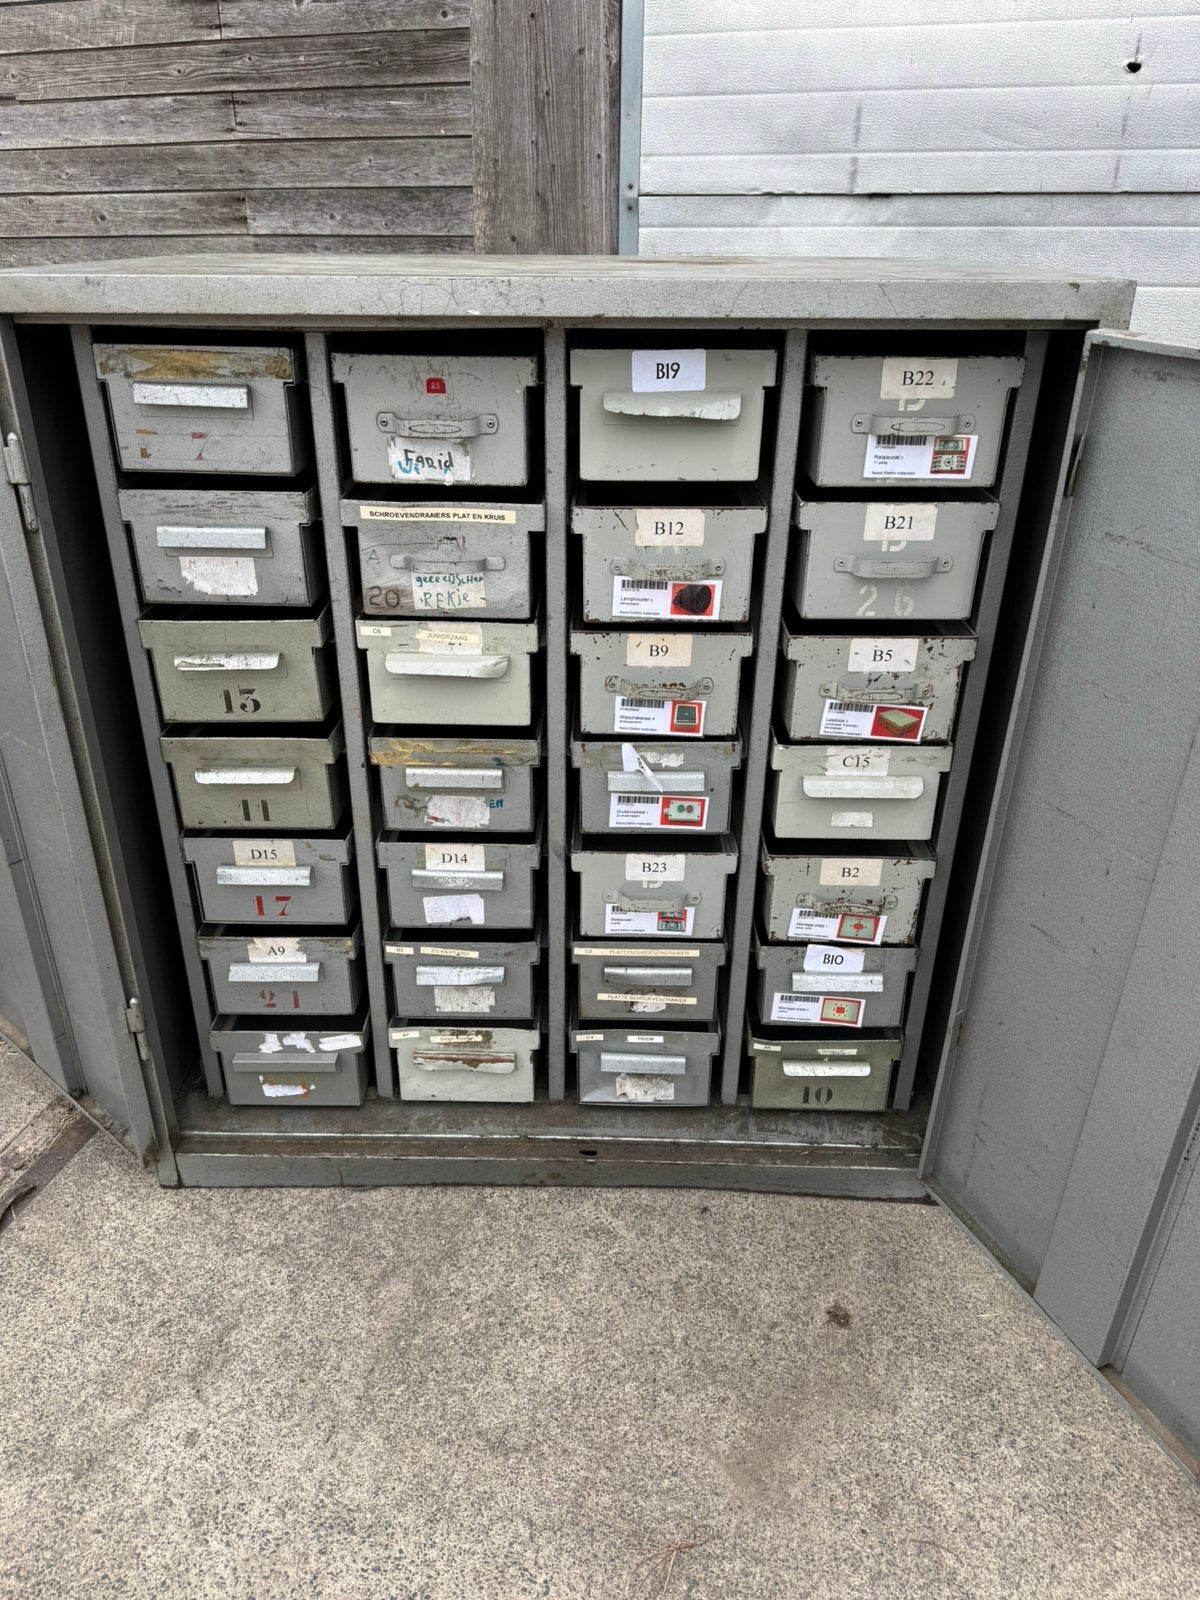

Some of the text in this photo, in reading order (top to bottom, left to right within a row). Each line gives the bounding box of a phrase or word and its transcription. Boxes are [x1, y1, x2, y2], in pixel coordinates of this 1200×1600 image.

[656, 362, 681, 380] B19
[902, 370, 935, 387] B22
[452, 512, 471, 520] PLAT
[484, 513, 506, 521] KRUIS
[884, 515, 914, 530] B21
[654, 521, 685, 536] B12
[649, 644, 670, 658] B9
[872, 649, 893, 662] B5
[842, 754, 871, 769] C15
[238, 799, 273, 822] 11
[250, 849, 279, 860] D15
[442, 853, 469, 864] D14
[642, 862, 667, 873] B23
[841, 867, 860, 878] B2
[253, 895, 292, 917] 17
[268, 946, 286, 956] A9
[800, 1086, 833, 1105] 10
